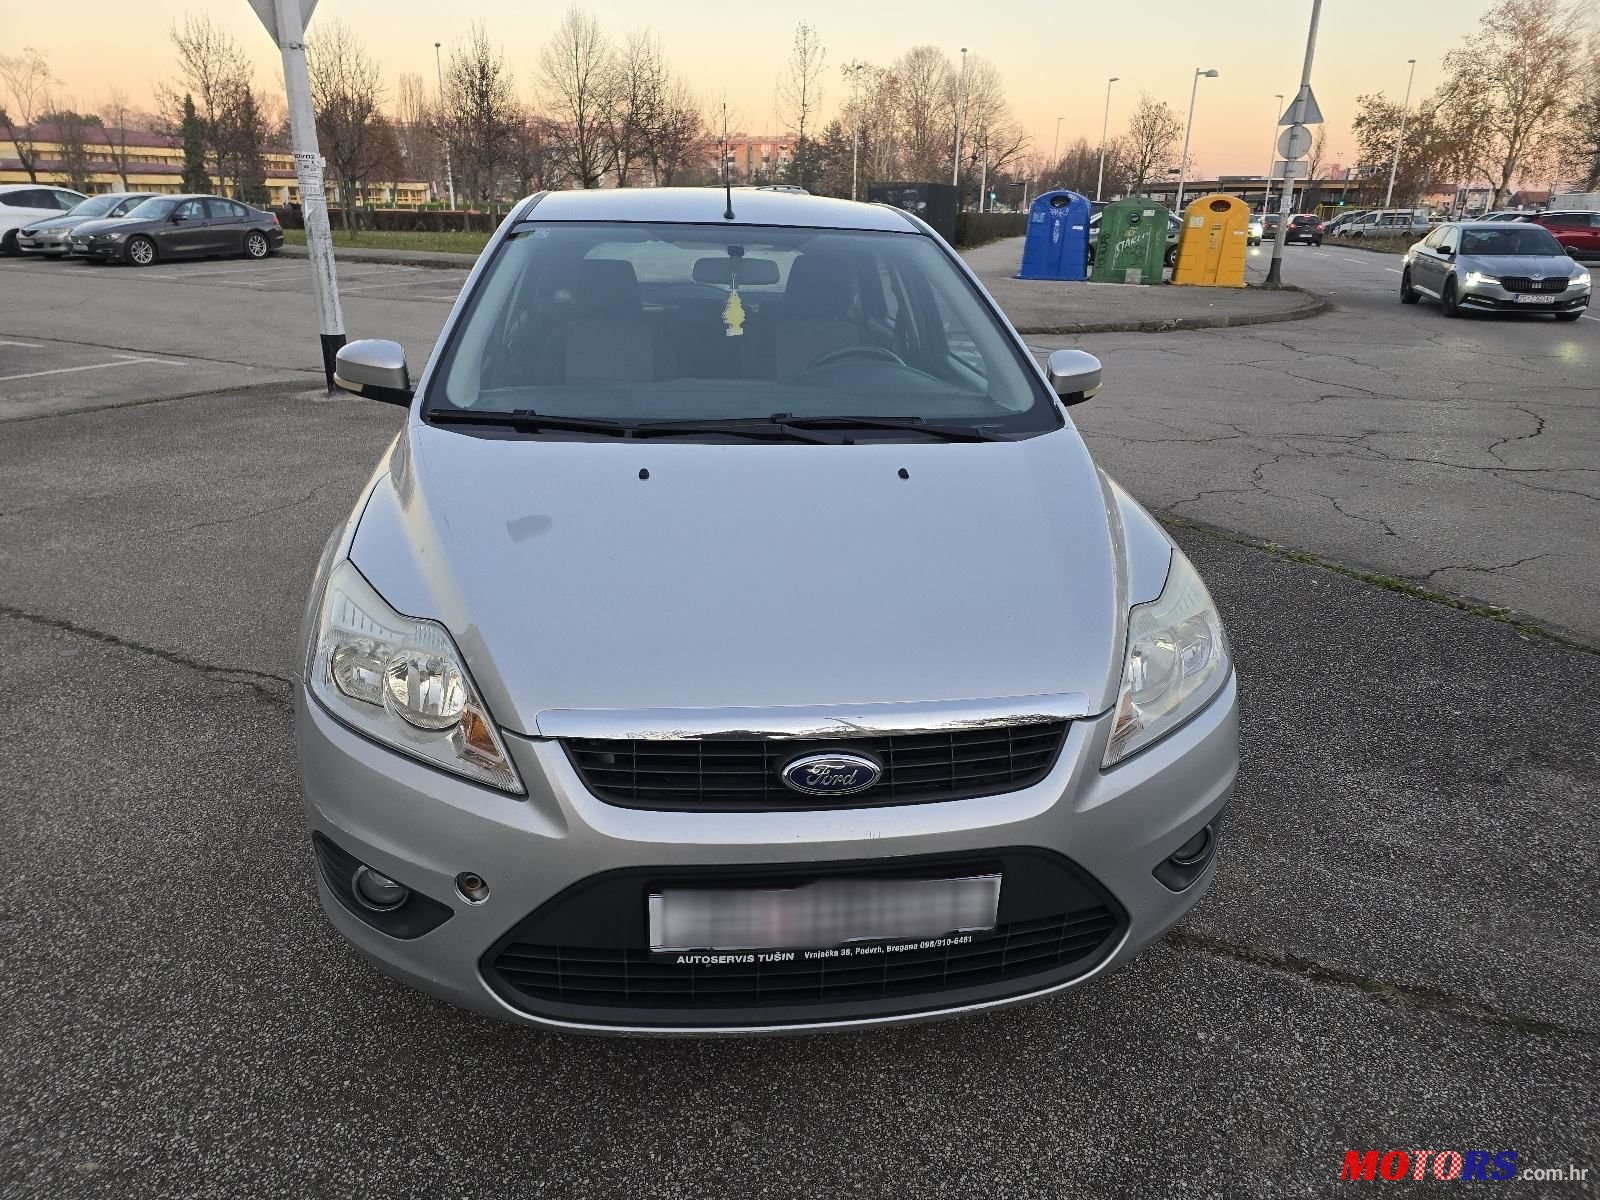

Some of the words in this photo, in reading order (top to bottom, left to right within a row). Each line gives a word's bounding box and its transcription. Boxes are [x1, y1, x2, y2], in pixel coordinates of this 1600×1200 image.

[805, 763, 859, 786] Ford
[676, 954, 755, 964] AUTOSERVIS
[758, 951, 795, 962] TUŠIN
[855, 945, 884, 955] Podvrh,
[886, 943, 918, 953] Bregana
